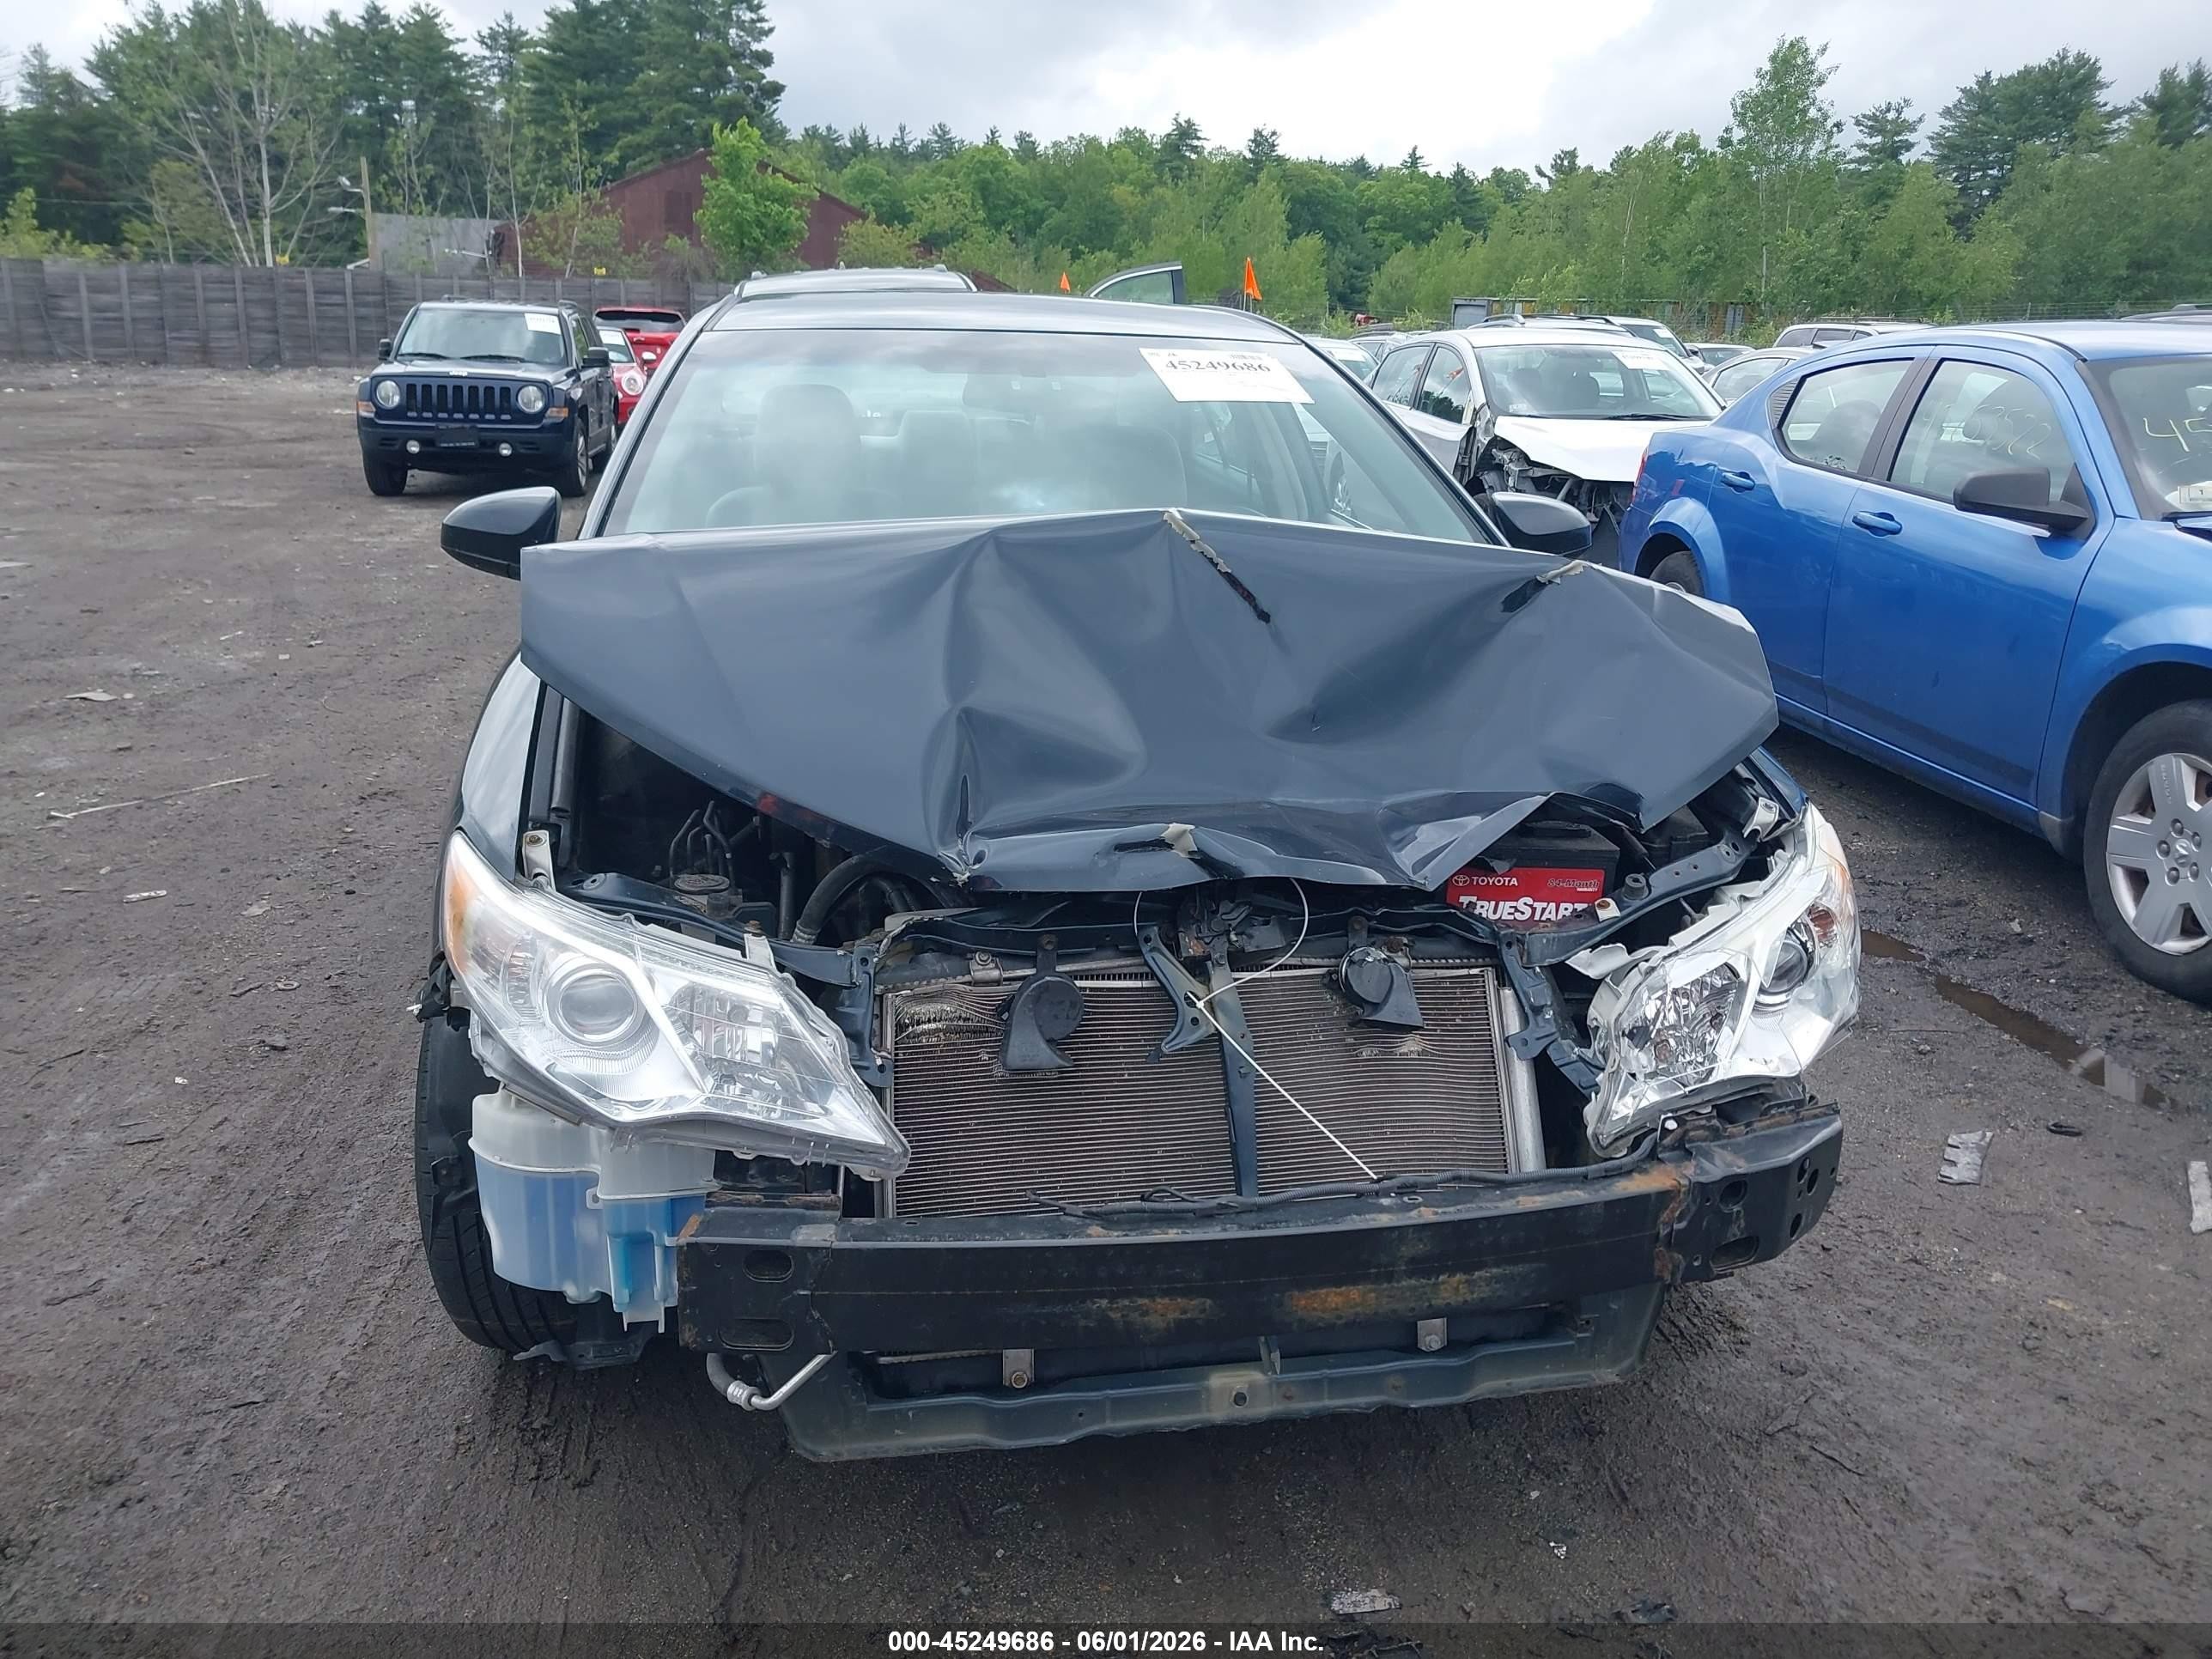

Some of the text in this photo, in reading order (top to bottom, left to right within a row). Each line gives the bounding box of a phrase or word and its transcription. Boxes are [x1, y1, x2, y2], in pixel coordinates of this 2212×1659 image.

[1164, 359, 1271, 373] 45249686
[1472, 876, 1518, 886] TOYOTA
[1547, 878, 1599, 888] 84-Month
